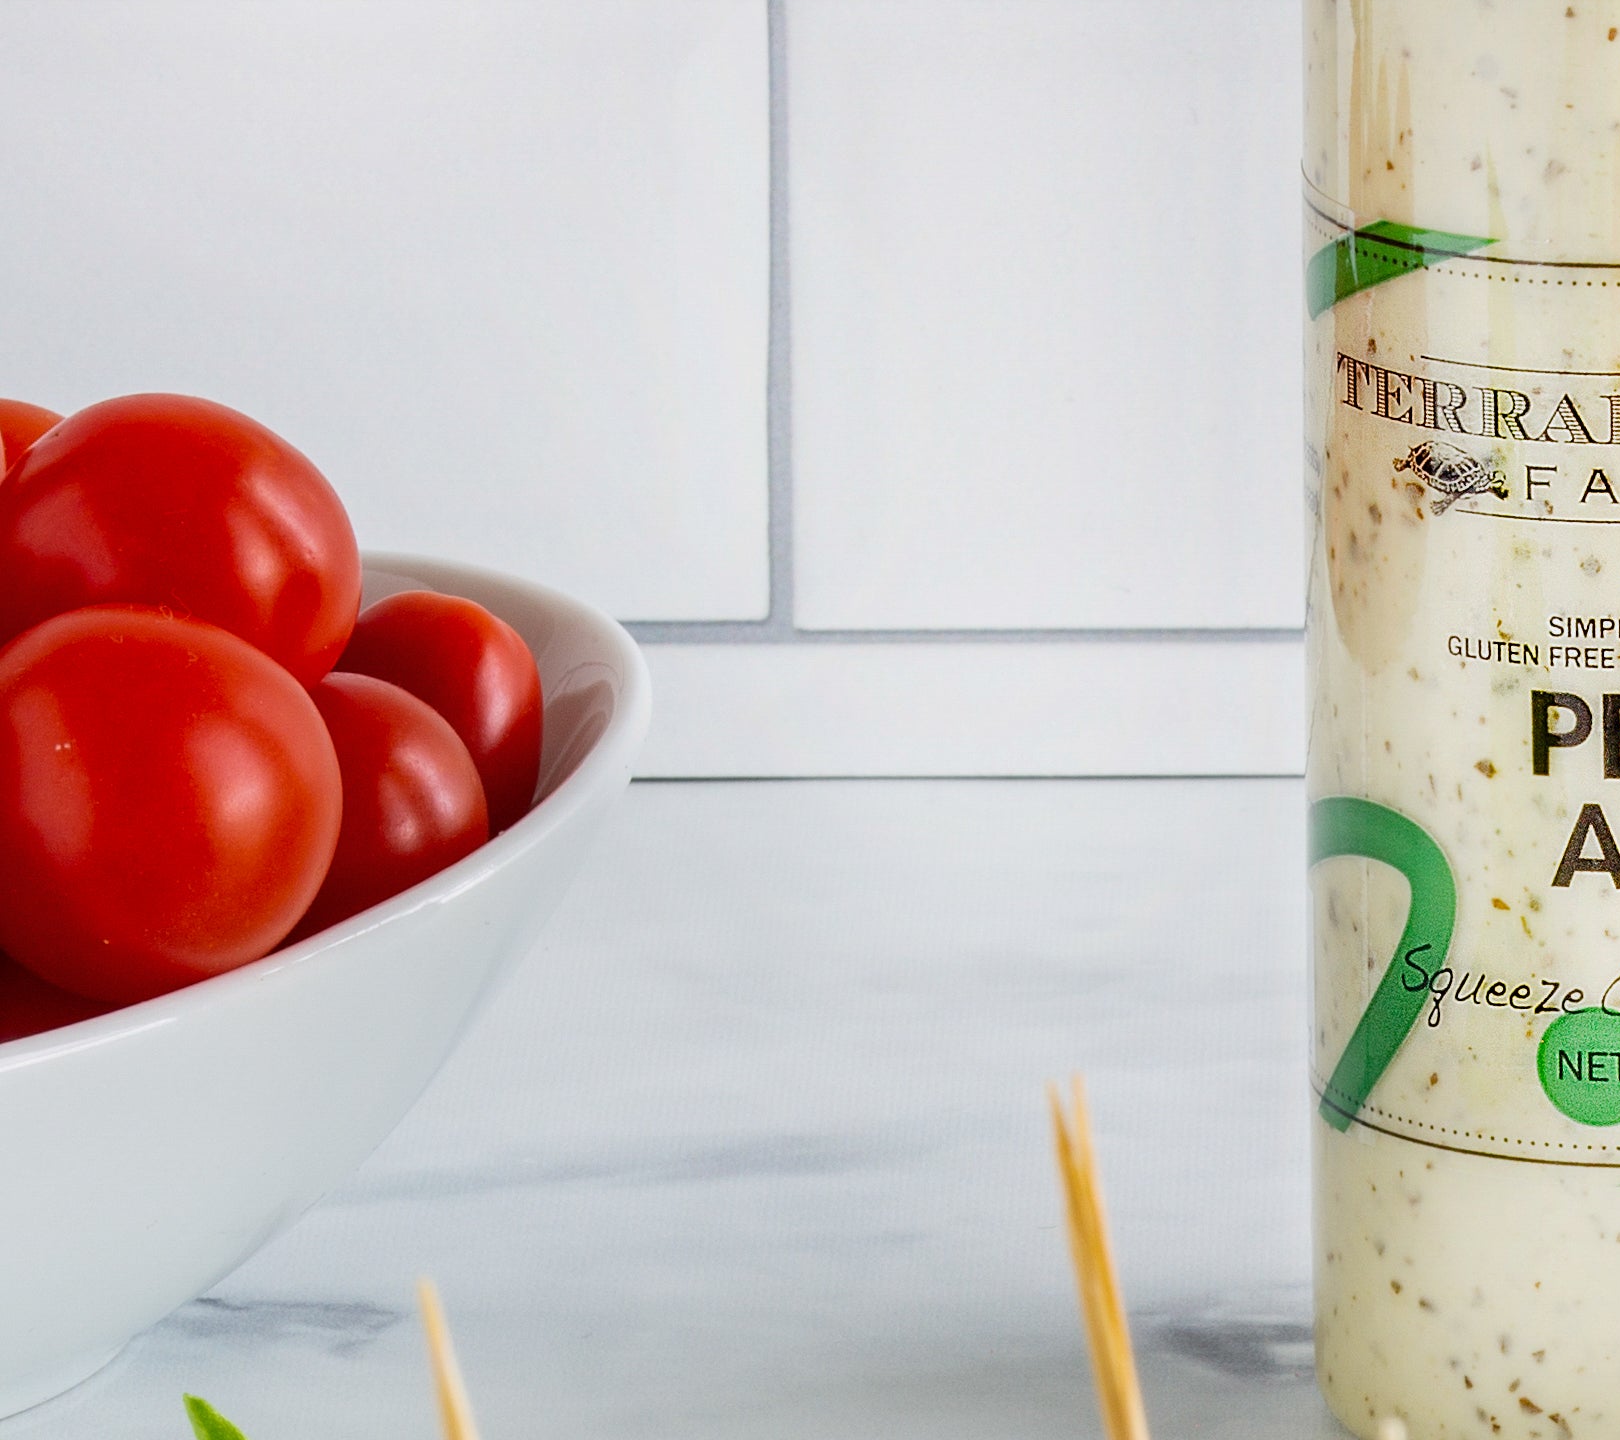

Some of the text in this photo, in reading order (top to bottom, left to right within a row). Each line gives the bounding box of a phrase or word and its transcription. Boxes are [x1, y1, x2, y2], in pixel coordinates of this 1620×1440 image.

[1448, 635, 1539, 666] GLUTEN
[1549, 646, 1615, 669] FREE
[1401, 943, 1585, 1028] Squeeze
